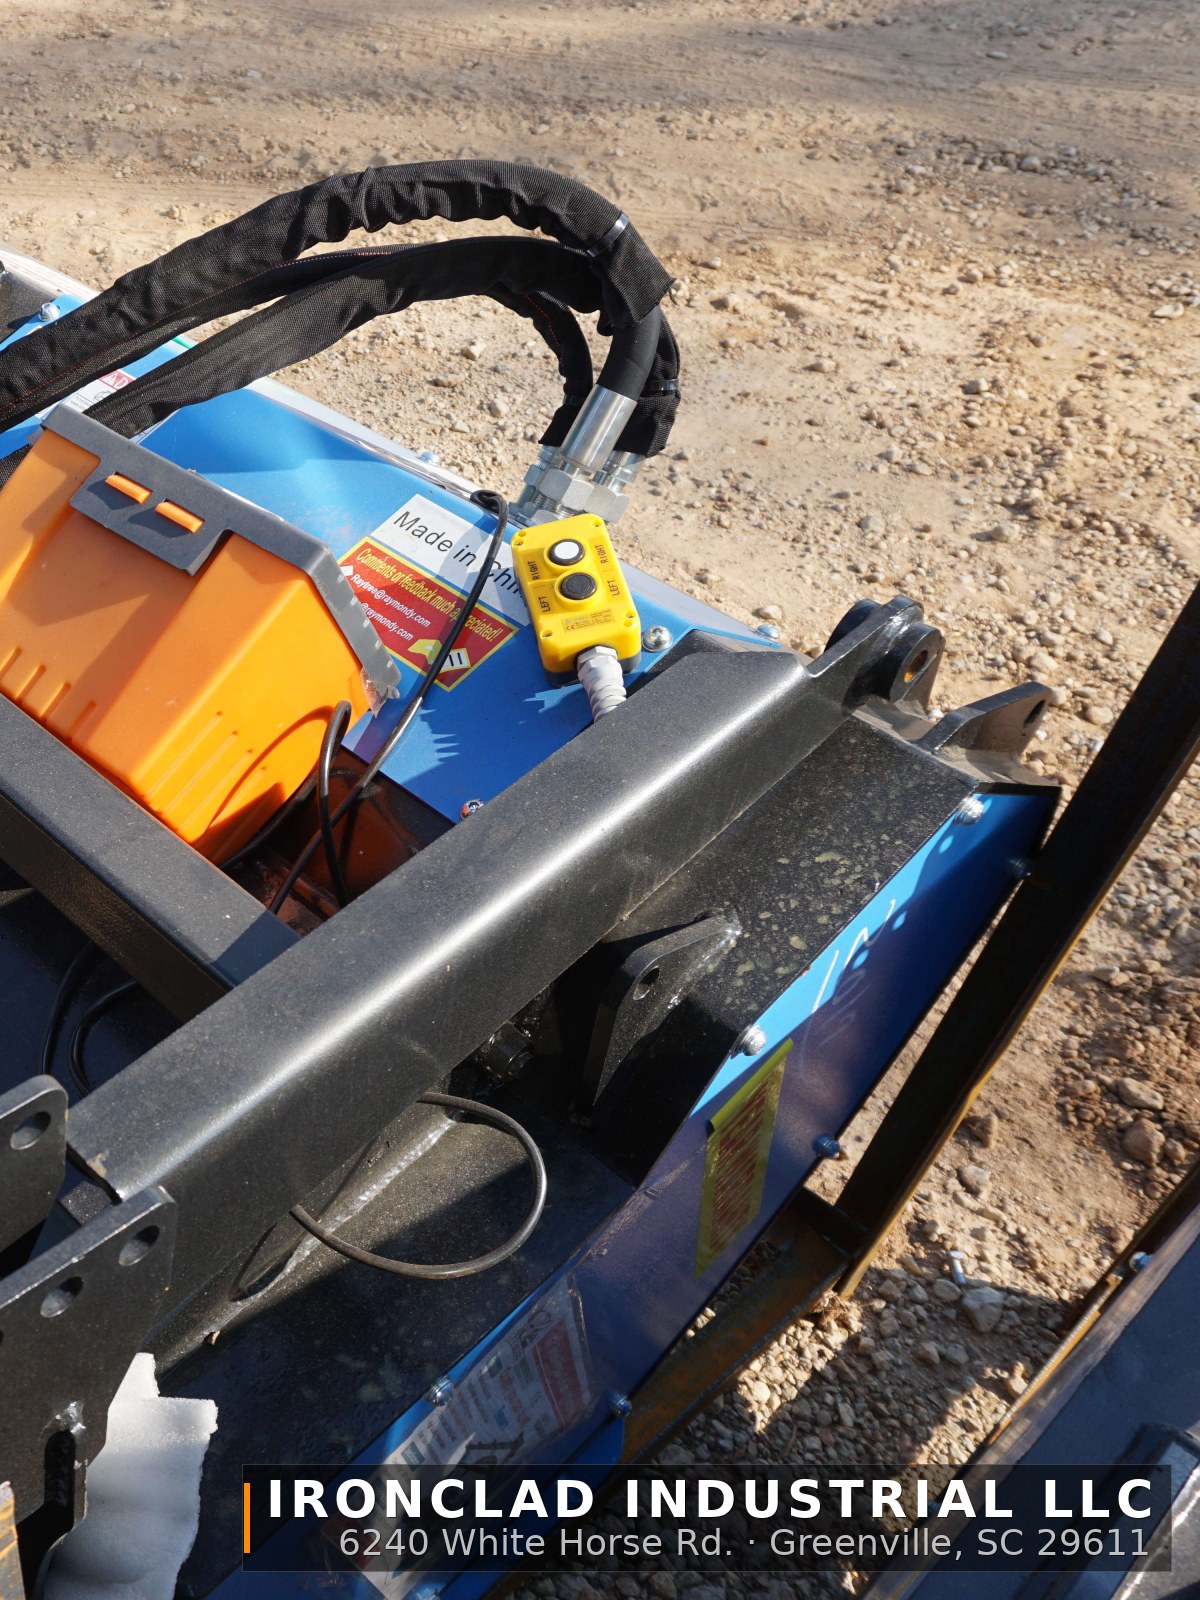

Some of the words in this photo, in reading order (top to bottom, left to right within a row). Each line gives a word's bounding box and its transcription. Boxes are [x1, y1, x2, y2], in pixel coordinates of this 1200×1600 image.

[393, 511, 453, 552] Made
[453, 544, 477, 567] in
[356, 548, 397, 579] Comments
[595, 544, 609, 564] RIGHT
[392, 571, 405, 583] or
[528, 561, 541, 580] RIGHT
[398, 573, 438, 603] feedback
[607, 580, 621, 596] LEFT
[429, 595, 457, 615] much
[538, 596, 551, 613] LEFT
[361, 602, 414, 641] @raymondy.com
[449, 607, 504, 642] apeciated!
